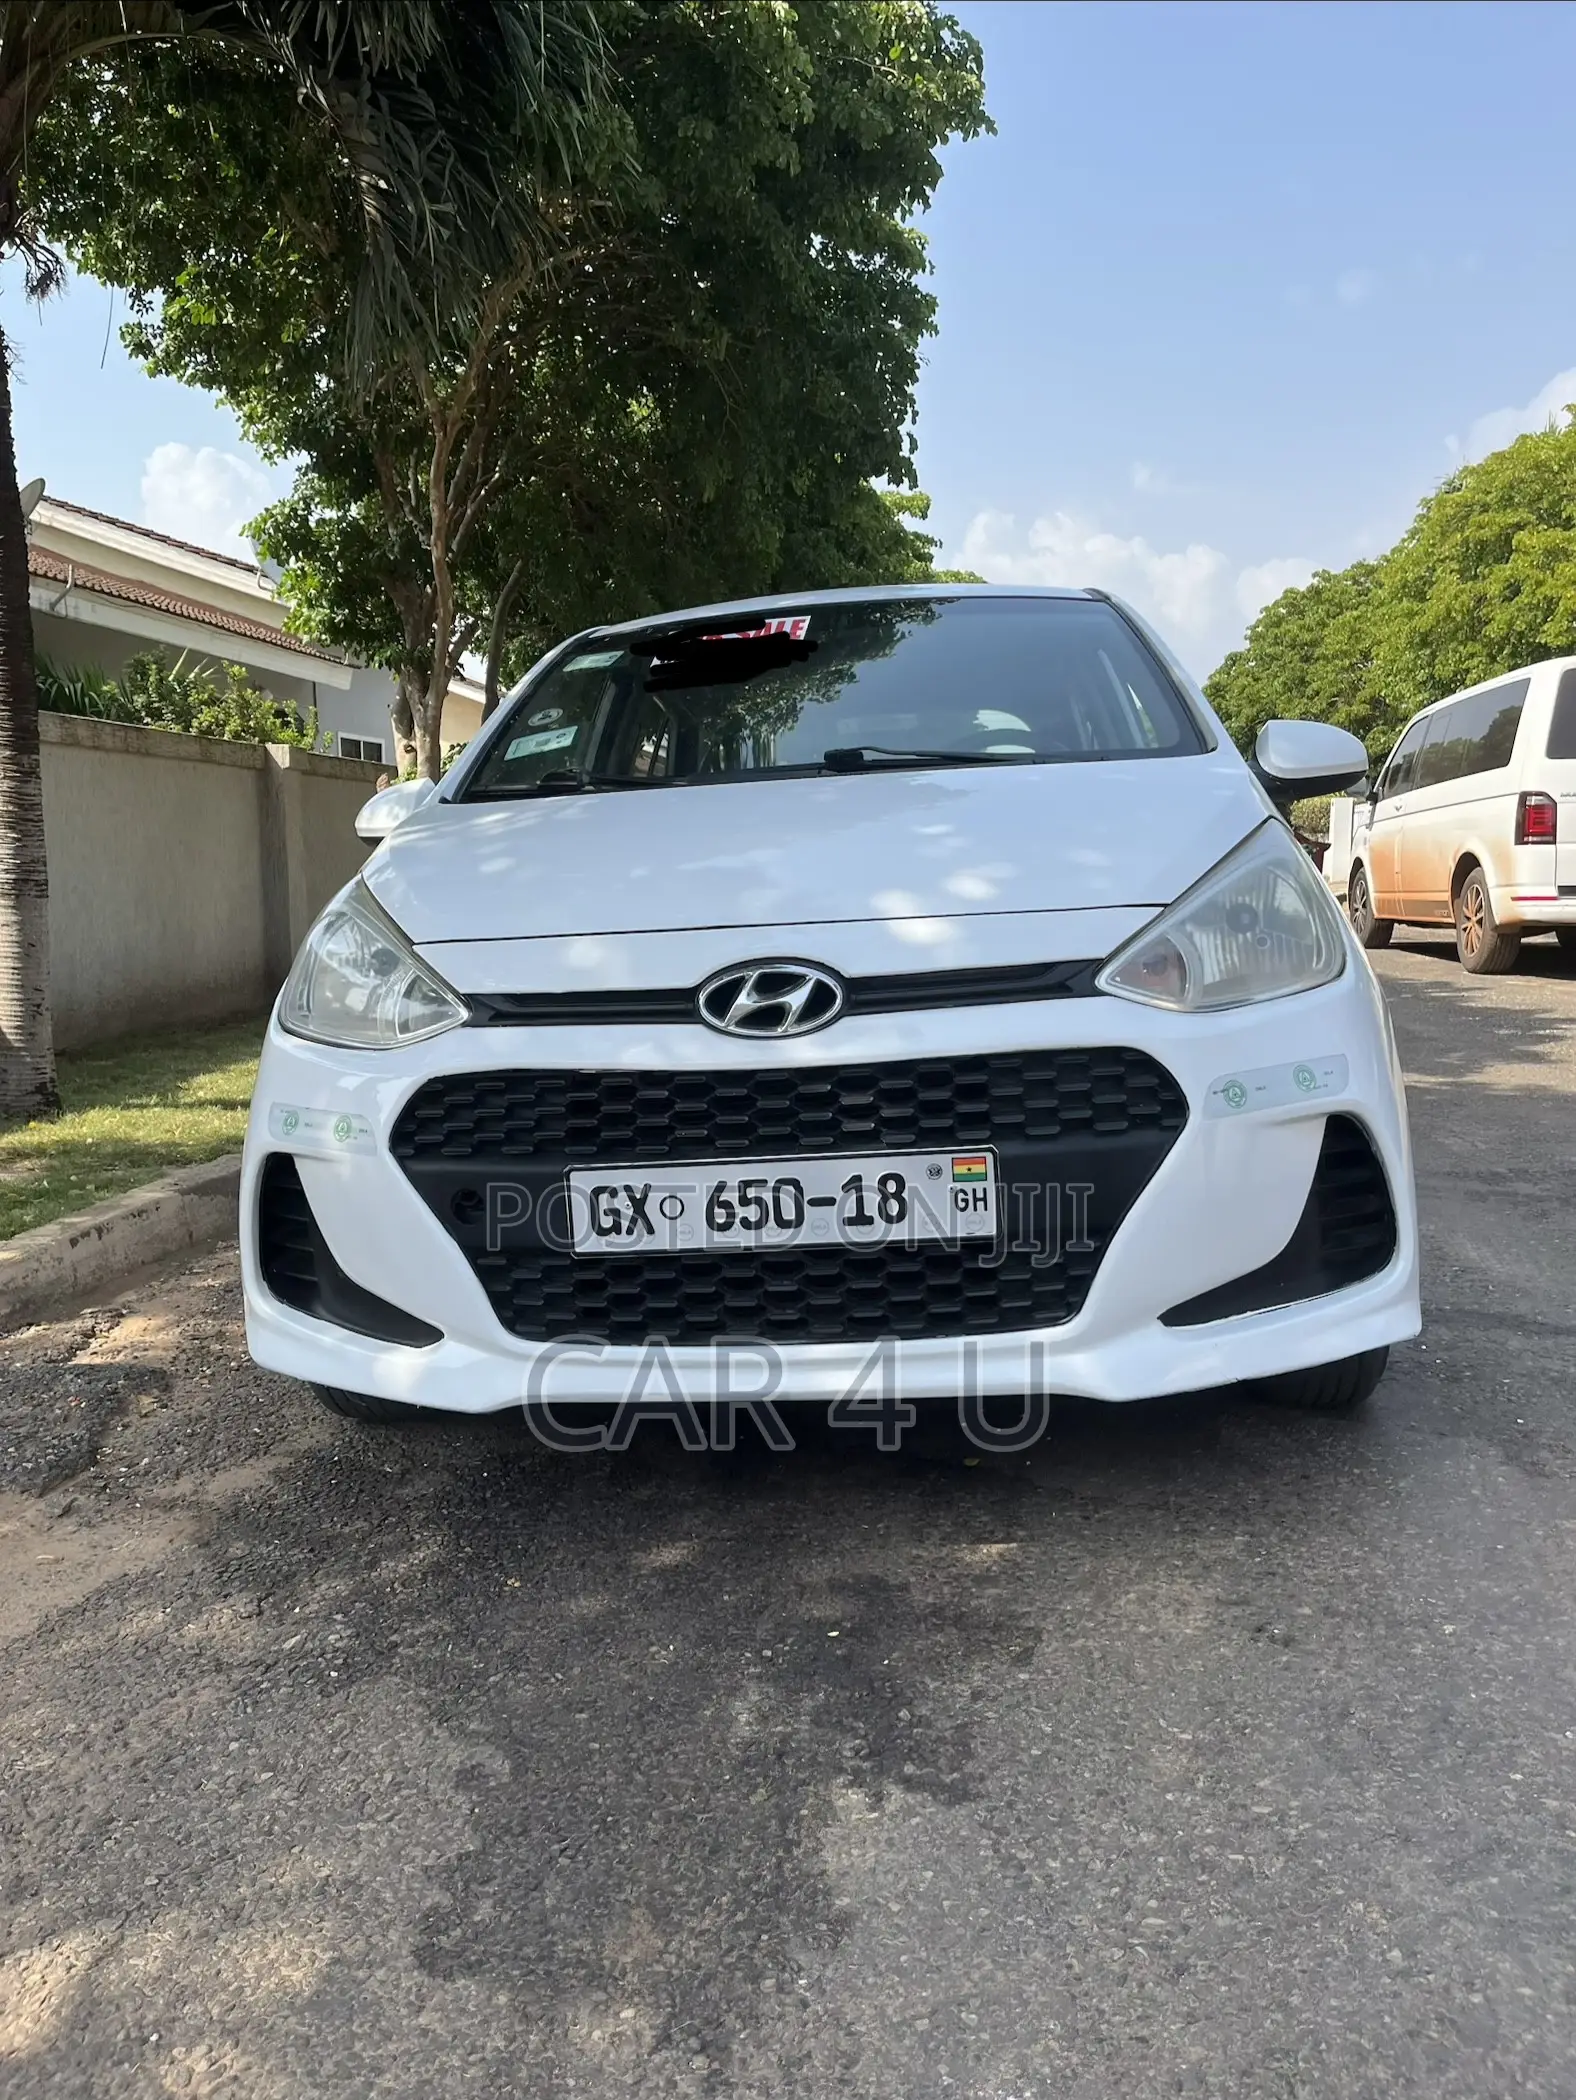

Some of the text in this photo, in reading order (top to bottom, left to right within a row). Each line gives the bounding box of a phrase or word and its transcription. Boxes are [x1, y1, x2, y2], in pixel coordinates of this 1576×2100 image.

[590, 1172, 907, 1236] GX 650-18
[954, 1187, 988, 1212] GH
